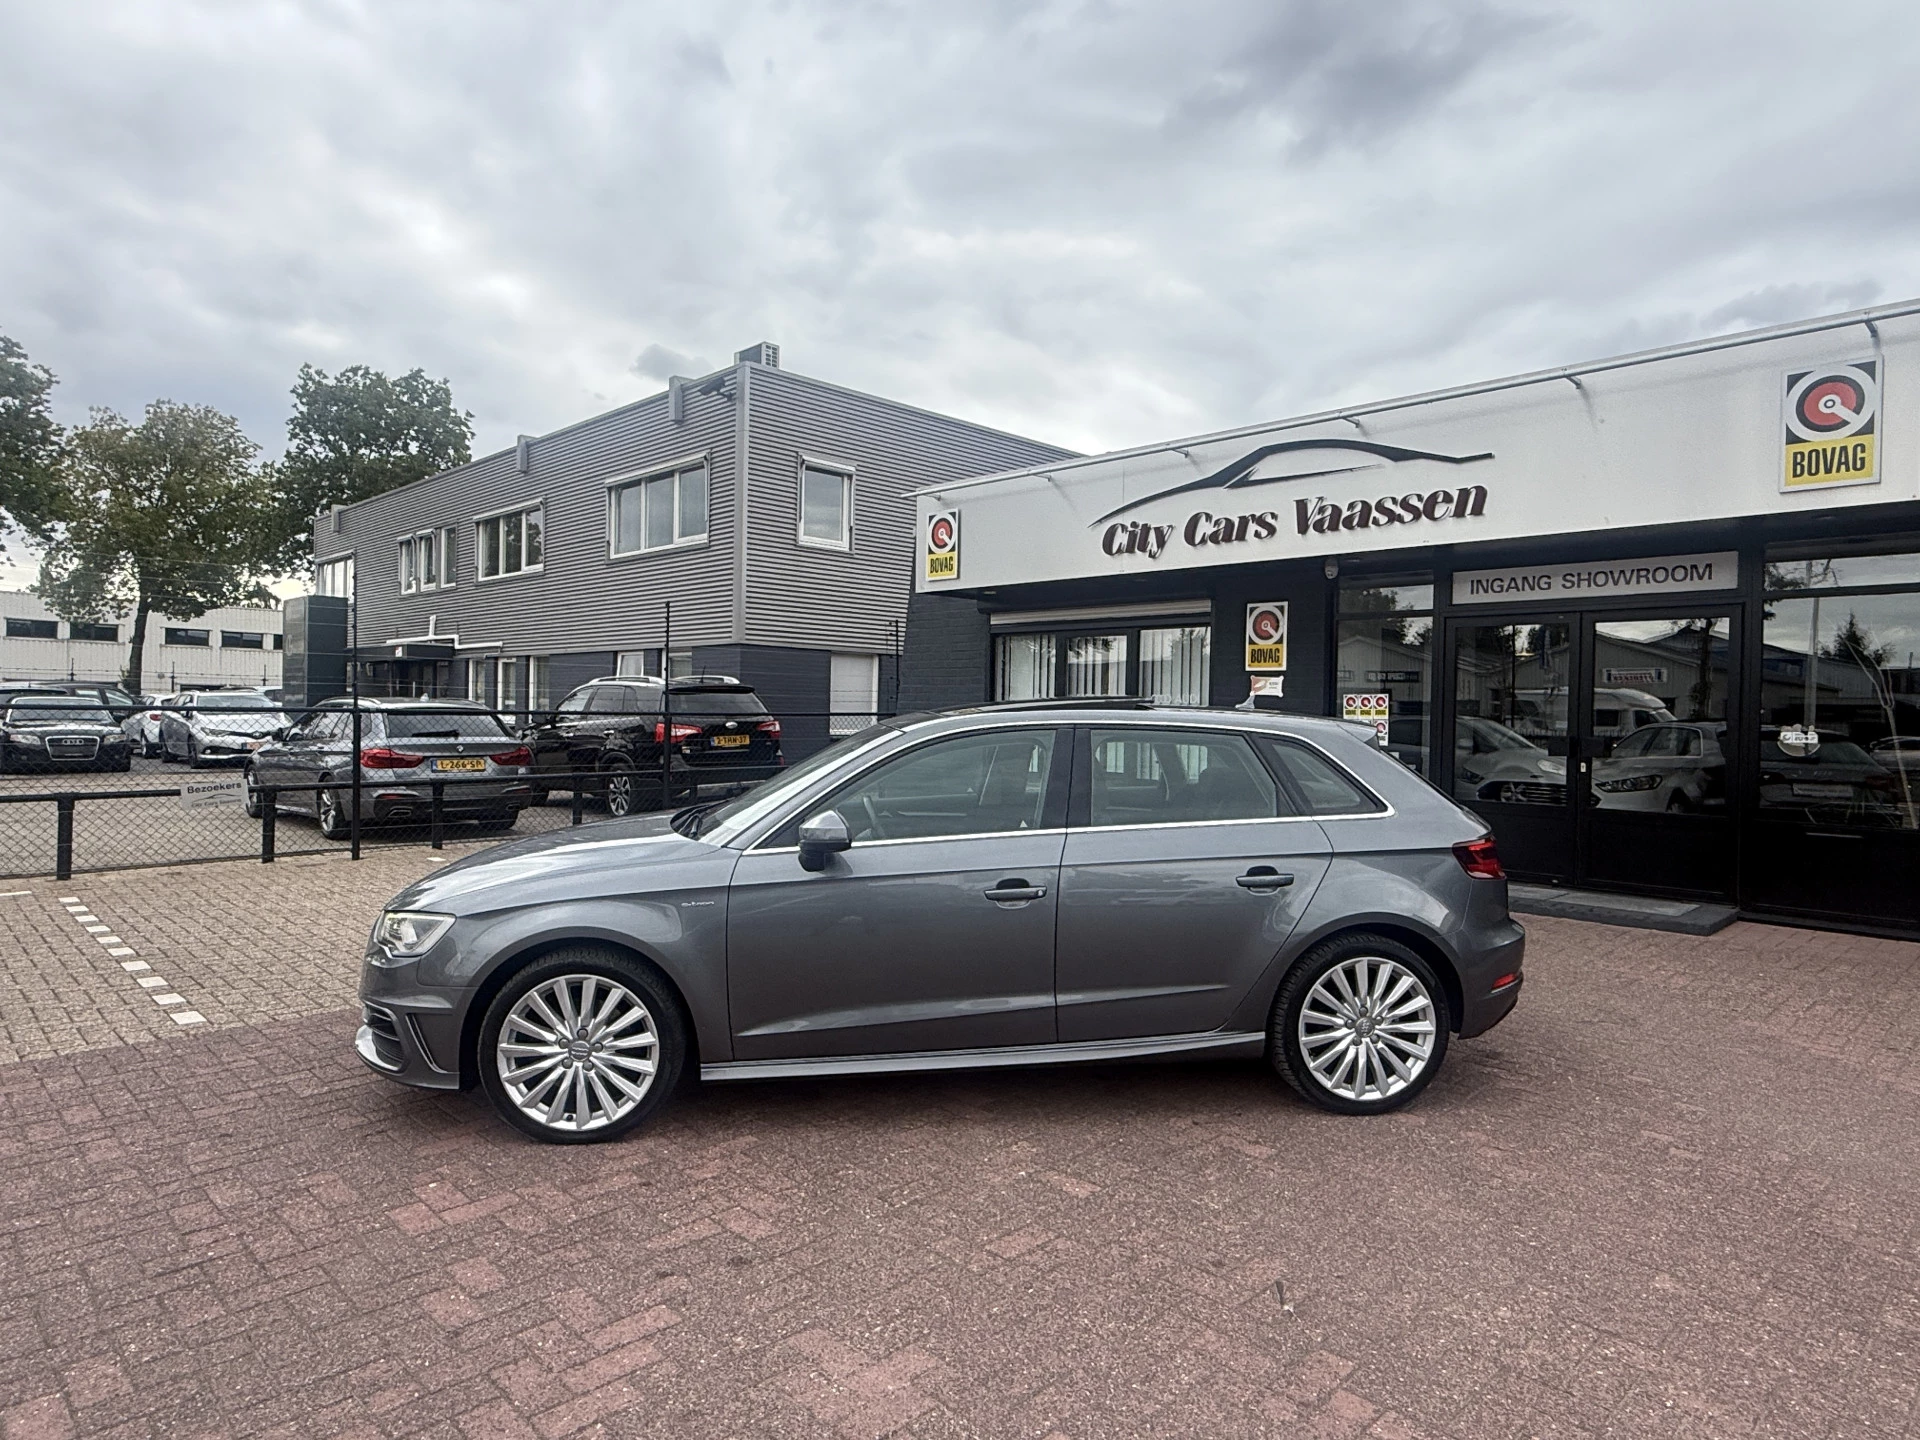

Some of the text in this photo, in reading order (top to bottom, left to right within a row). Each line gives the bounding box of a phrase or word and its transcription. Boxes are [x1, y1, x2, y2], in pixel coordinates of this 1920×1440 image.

[1792, 443, 1866, 478] BOVAG
[1102, 484, 1489, 559] City Cars Vaassen
[929, 556, 954, 574] BOVAG
[1469, 562, 1713, 595] INGANG SHOWROOM
[1250, 648, 1280, 664] BOVAG
[187, 782, 242, 794] Bezoekers
